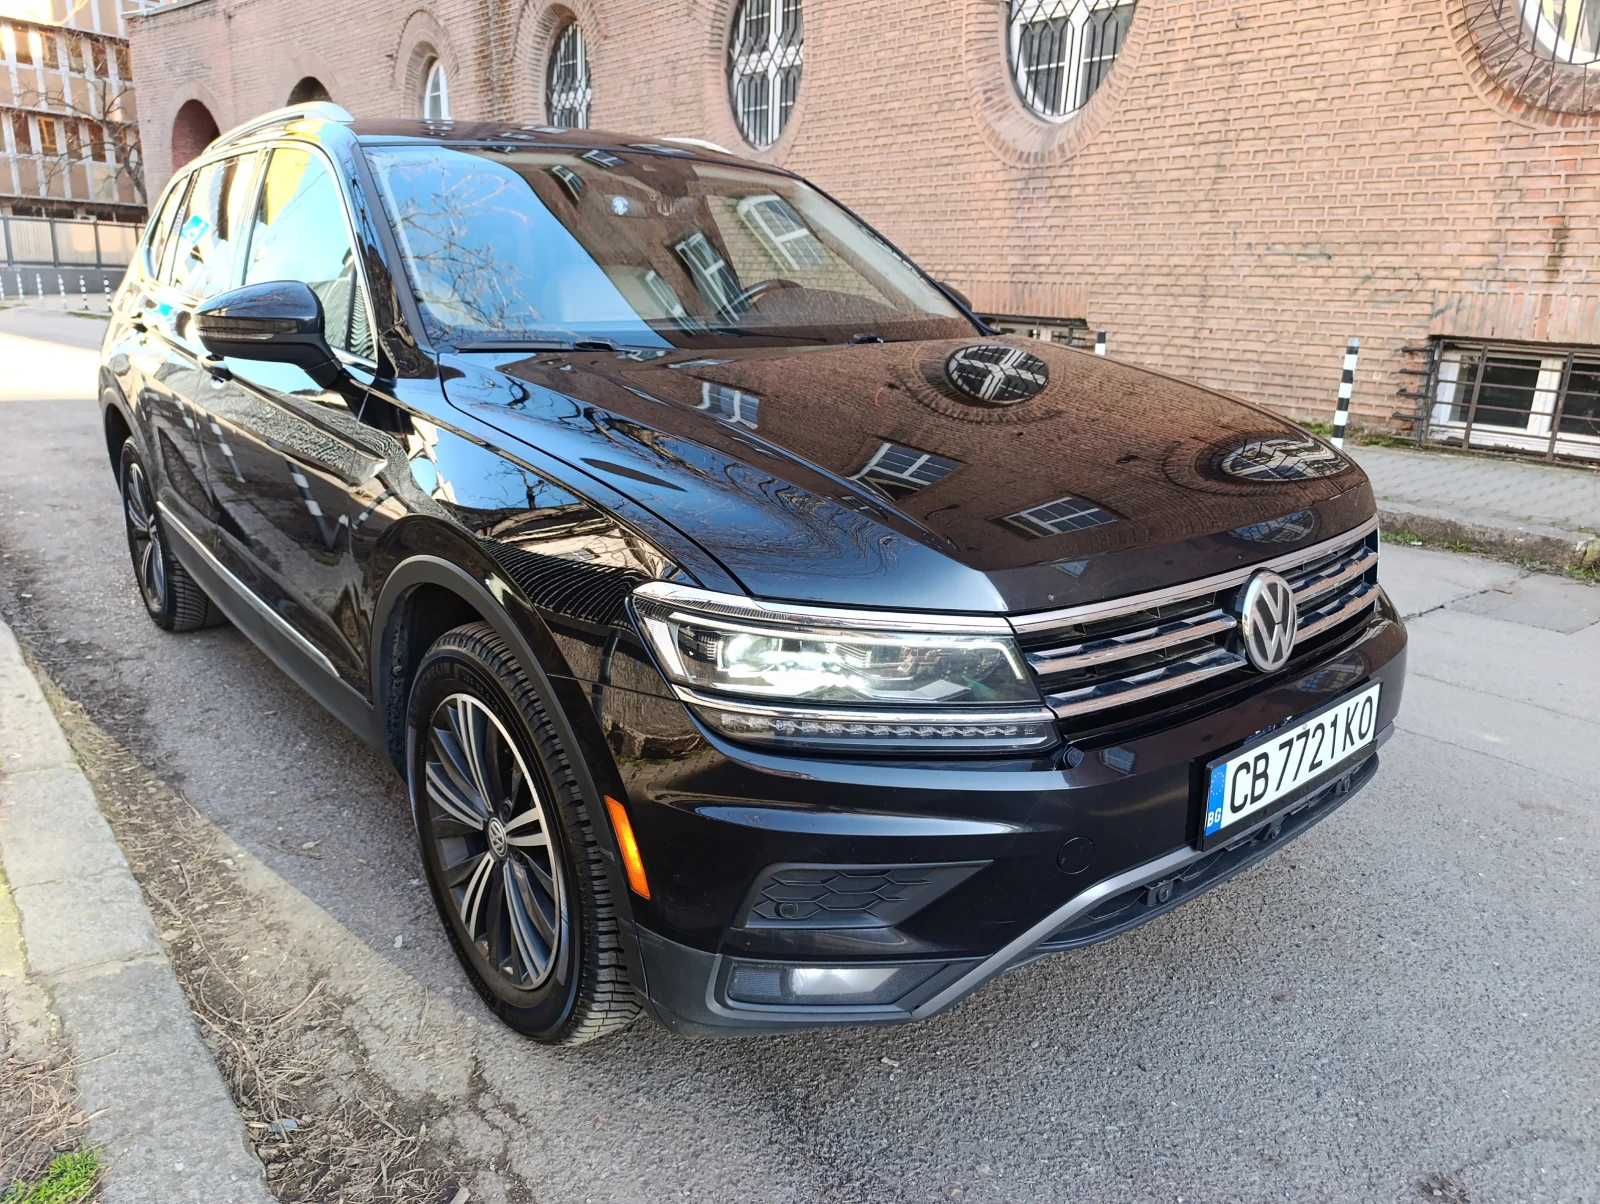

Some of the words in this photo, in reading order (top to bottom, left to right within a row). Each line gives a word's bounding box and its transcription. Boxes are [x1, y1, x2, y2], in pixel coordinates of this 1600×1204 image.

[1245, 571, 1296, 671] VW
[1230, 752, 1269, 814] CB
[1275, 714, 1339, 792] 7721
[1342, 695, 1373, 752] KO
[1207, 807, 1222, 828] BG
